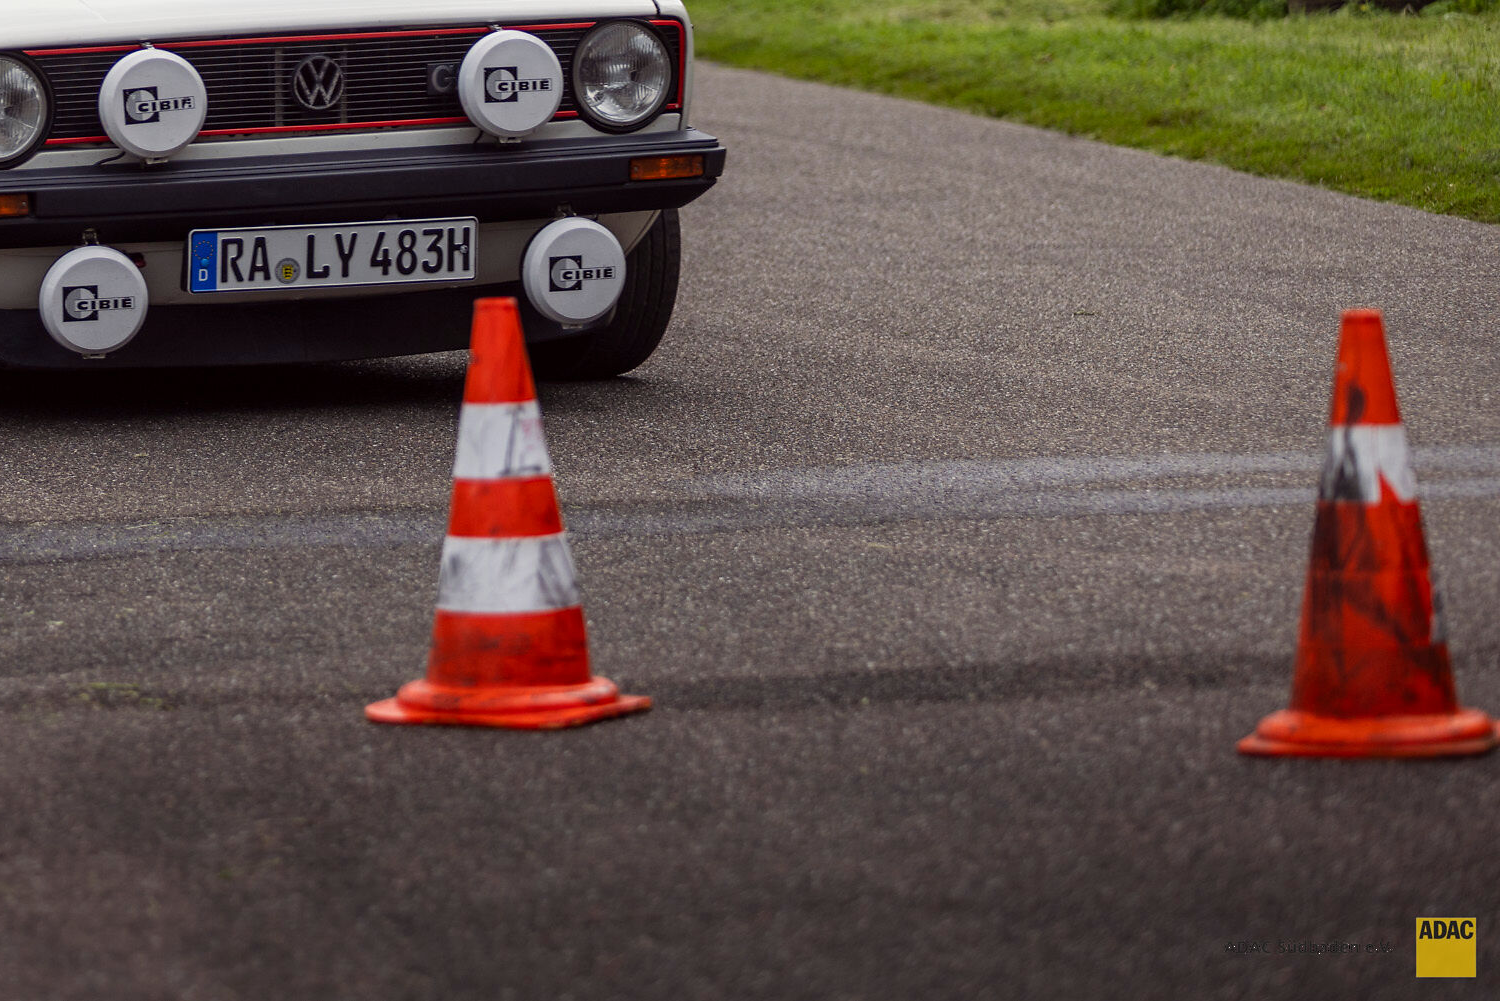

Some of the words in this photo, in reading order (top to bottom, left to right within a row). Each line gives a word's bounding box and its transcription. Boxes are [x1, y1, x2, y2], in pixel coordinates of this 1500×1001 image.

[498, 80, 549, 91] CIBIE
[220, 236, 272, 284] RA
[306, 232, 358, 279] LY
[370, 226, 471, 277] 483H
[197, 269, 209, 282] D
[562, 268, 613, 280] CIBIE
[77, 299, 132, 310] CIBIE
